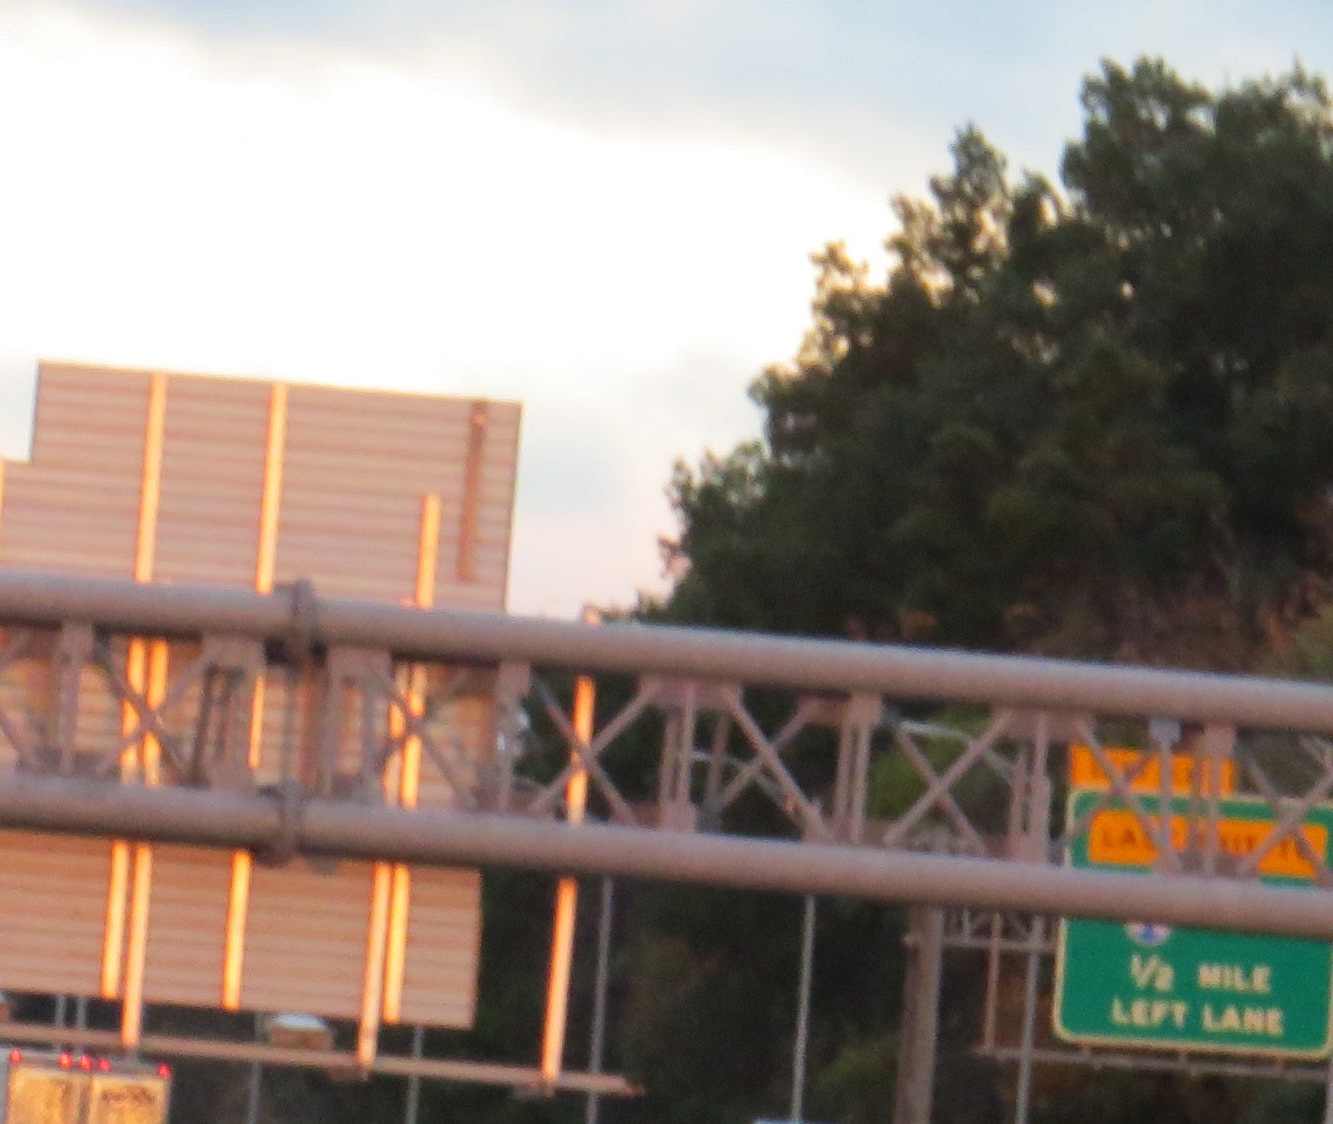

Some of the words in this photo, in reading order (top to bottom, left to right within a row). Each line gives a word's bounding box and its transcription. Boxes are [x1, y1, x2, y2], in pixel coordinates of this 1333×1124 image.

[1196, 961, 1272, 994] MILE
[1110, 996, 1188, 1029] LEFT
[1202, 1002, 1284, 1036] LANE
